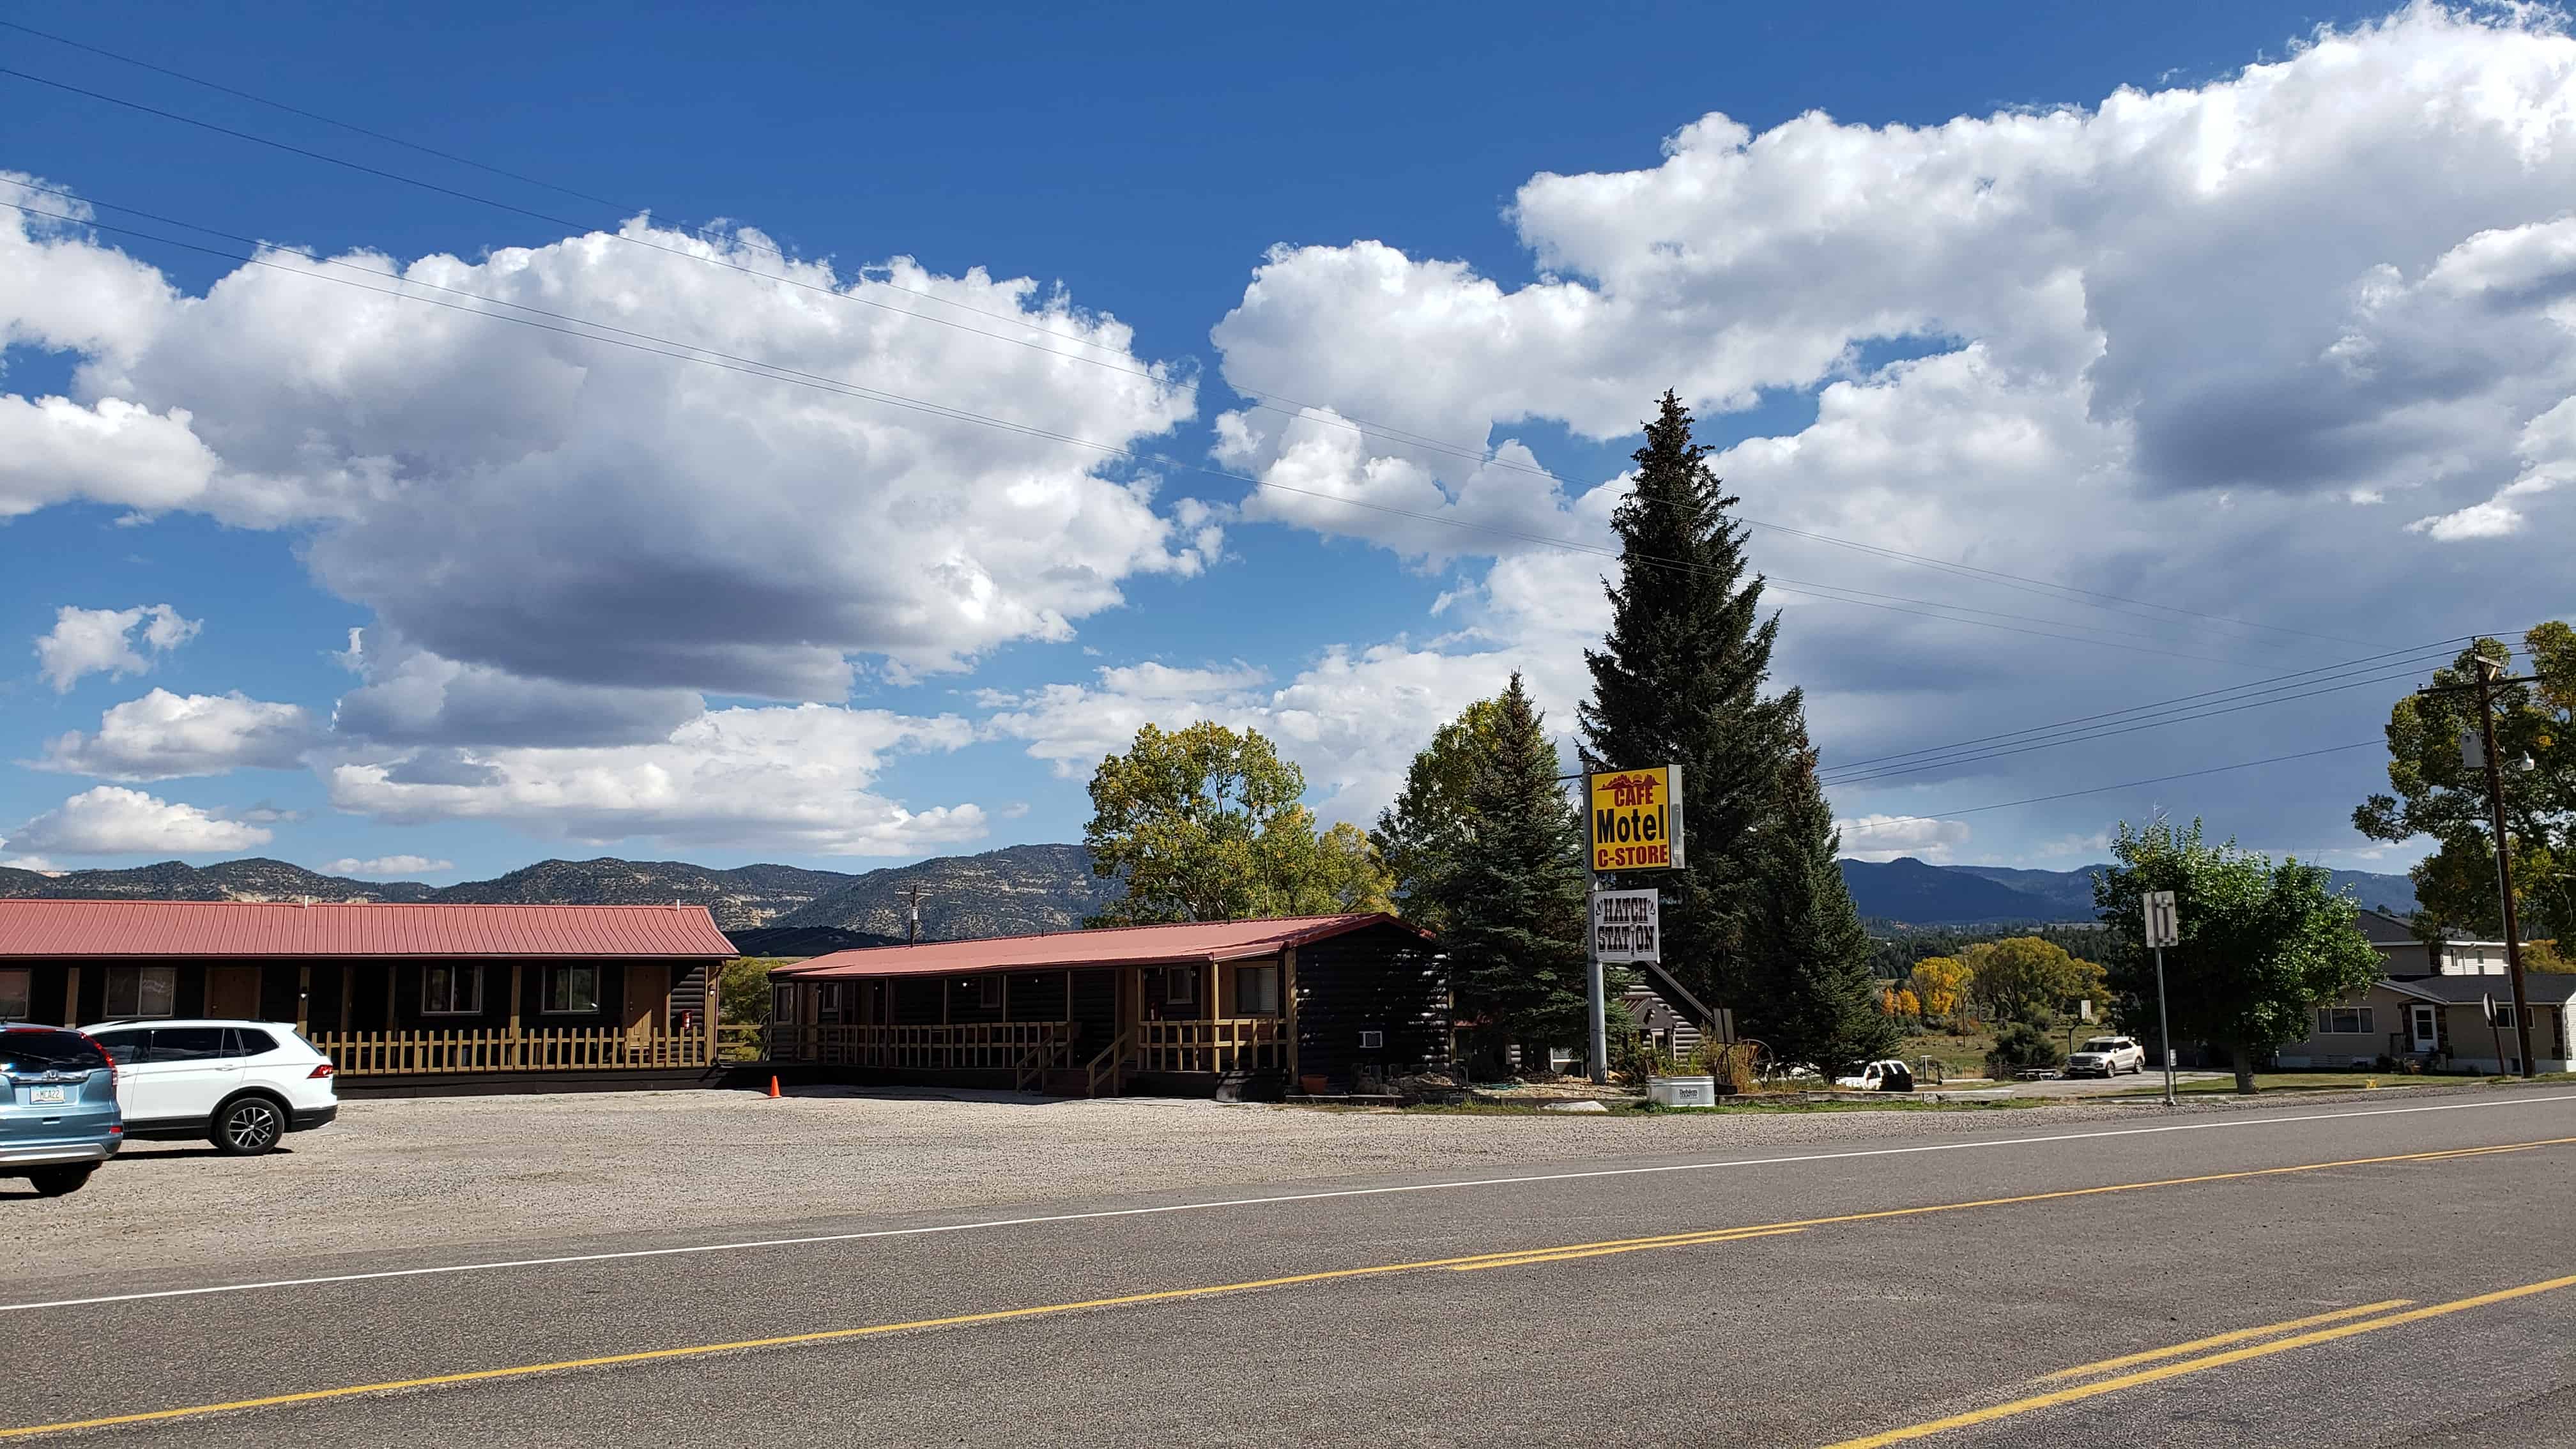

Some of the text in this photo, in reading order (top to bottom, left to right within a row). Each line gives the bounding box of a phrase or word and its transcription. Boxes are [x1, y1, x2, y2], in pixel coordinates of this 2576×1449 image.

[1614, 784, 1653, 806] CAFE
[1597, 804, 1664, 843] Motel
[1597, 845, 1667, 867] C-STORE
[1604, 898, 1648, 924] HATCH
[1598, 924, 1654, 957] STATION
